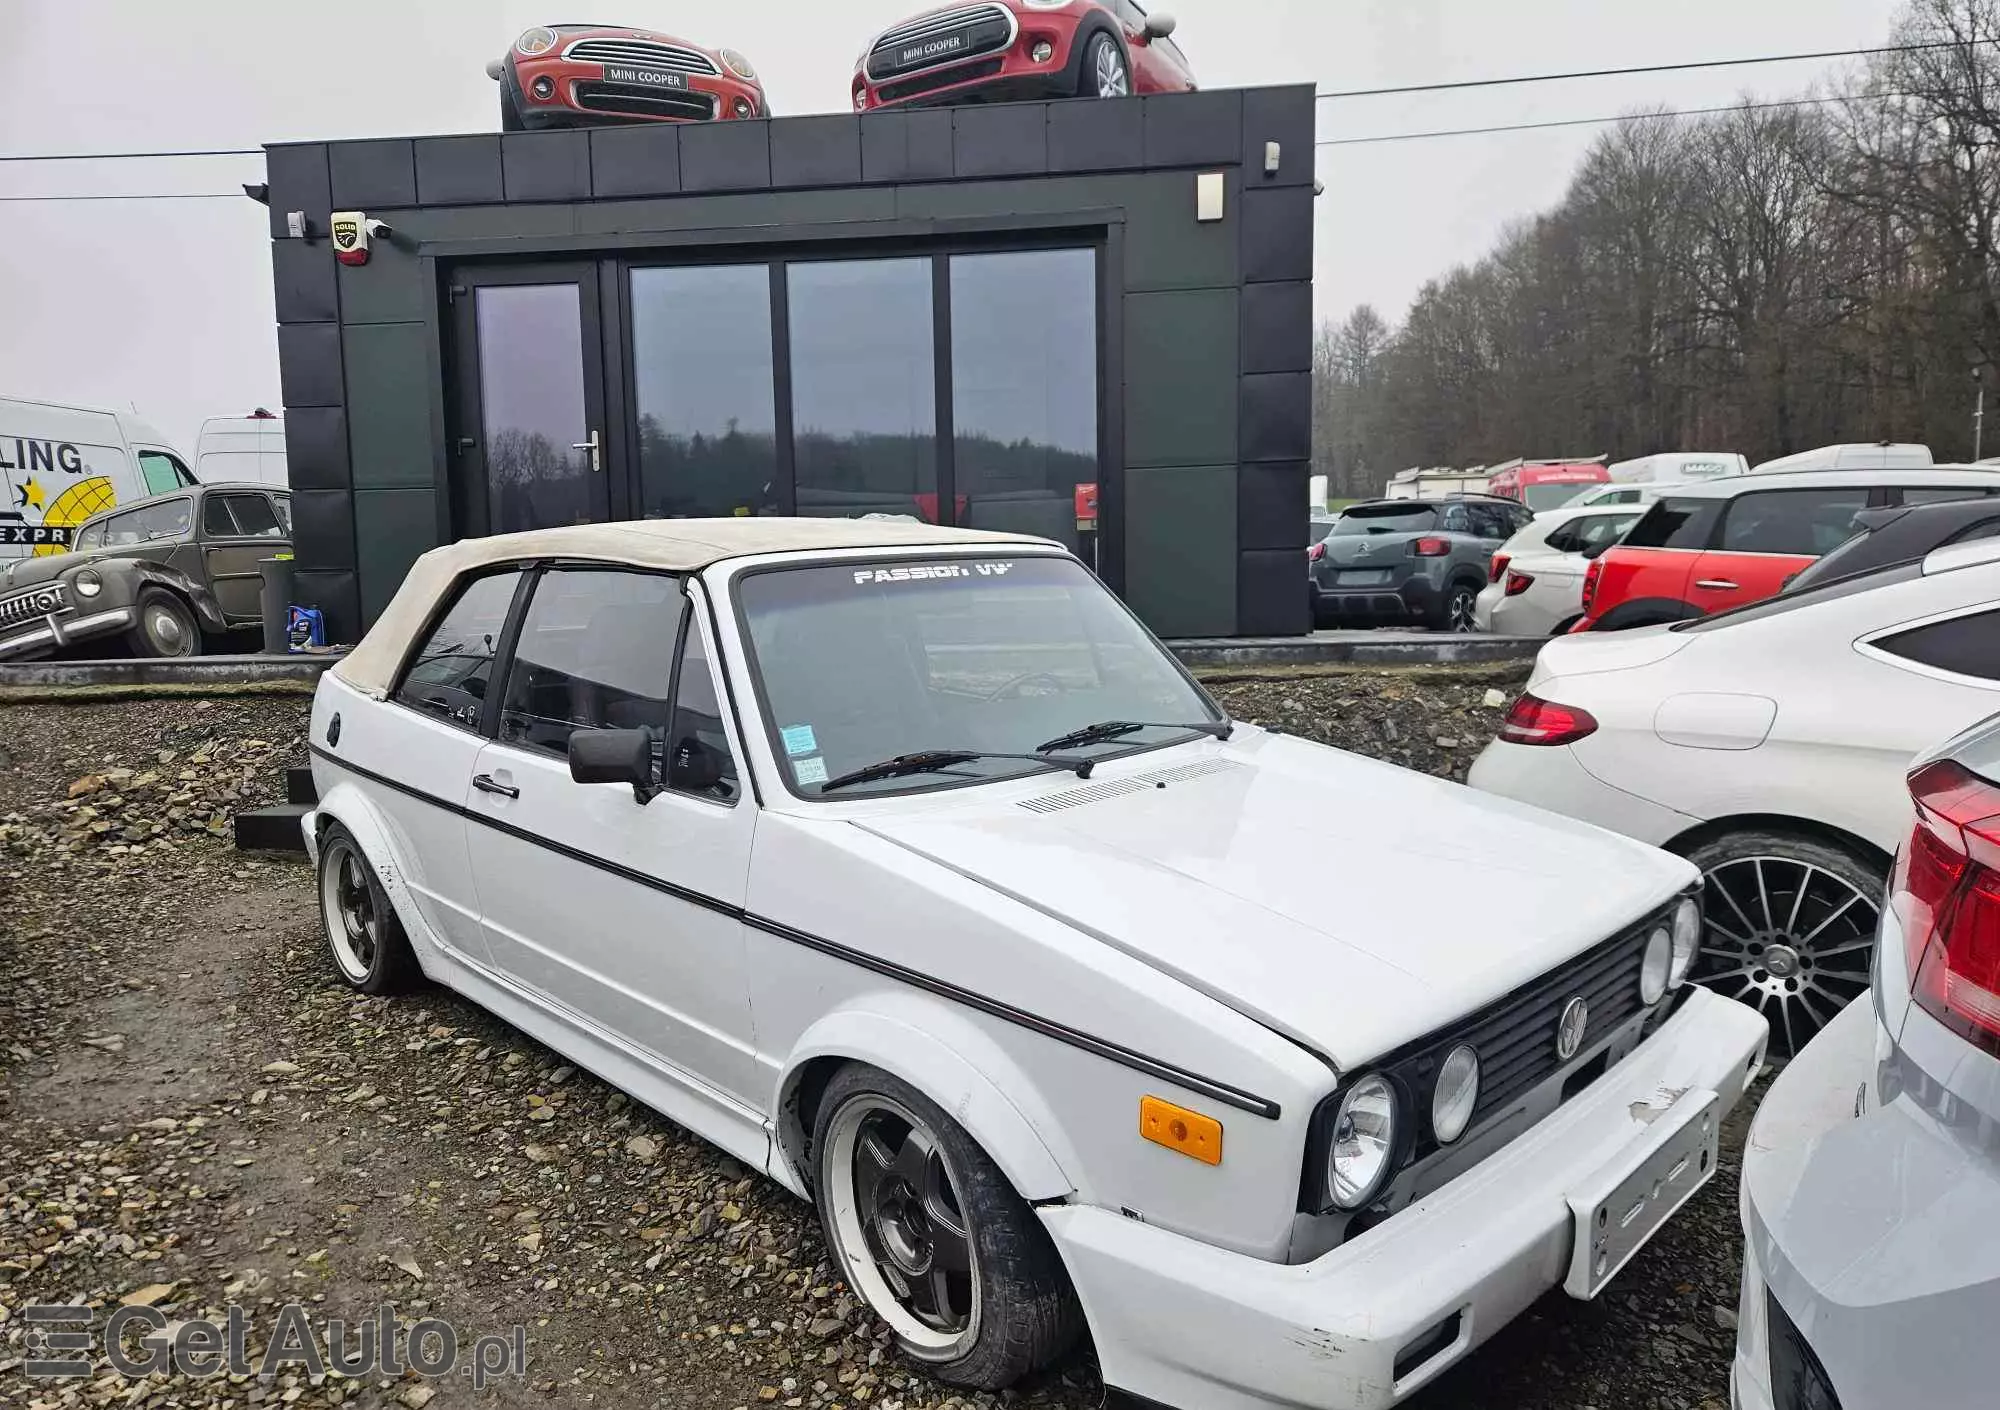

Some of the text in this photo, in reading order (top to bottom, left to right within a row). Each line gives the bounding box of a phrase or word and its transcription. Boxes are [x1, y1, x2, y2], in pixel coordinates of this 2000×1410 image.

[903, 36, 960, 60] MINI COOPER
[610, 69, 680, 86] MINI COOPER
[335, 223, 356, 231] SOLID
